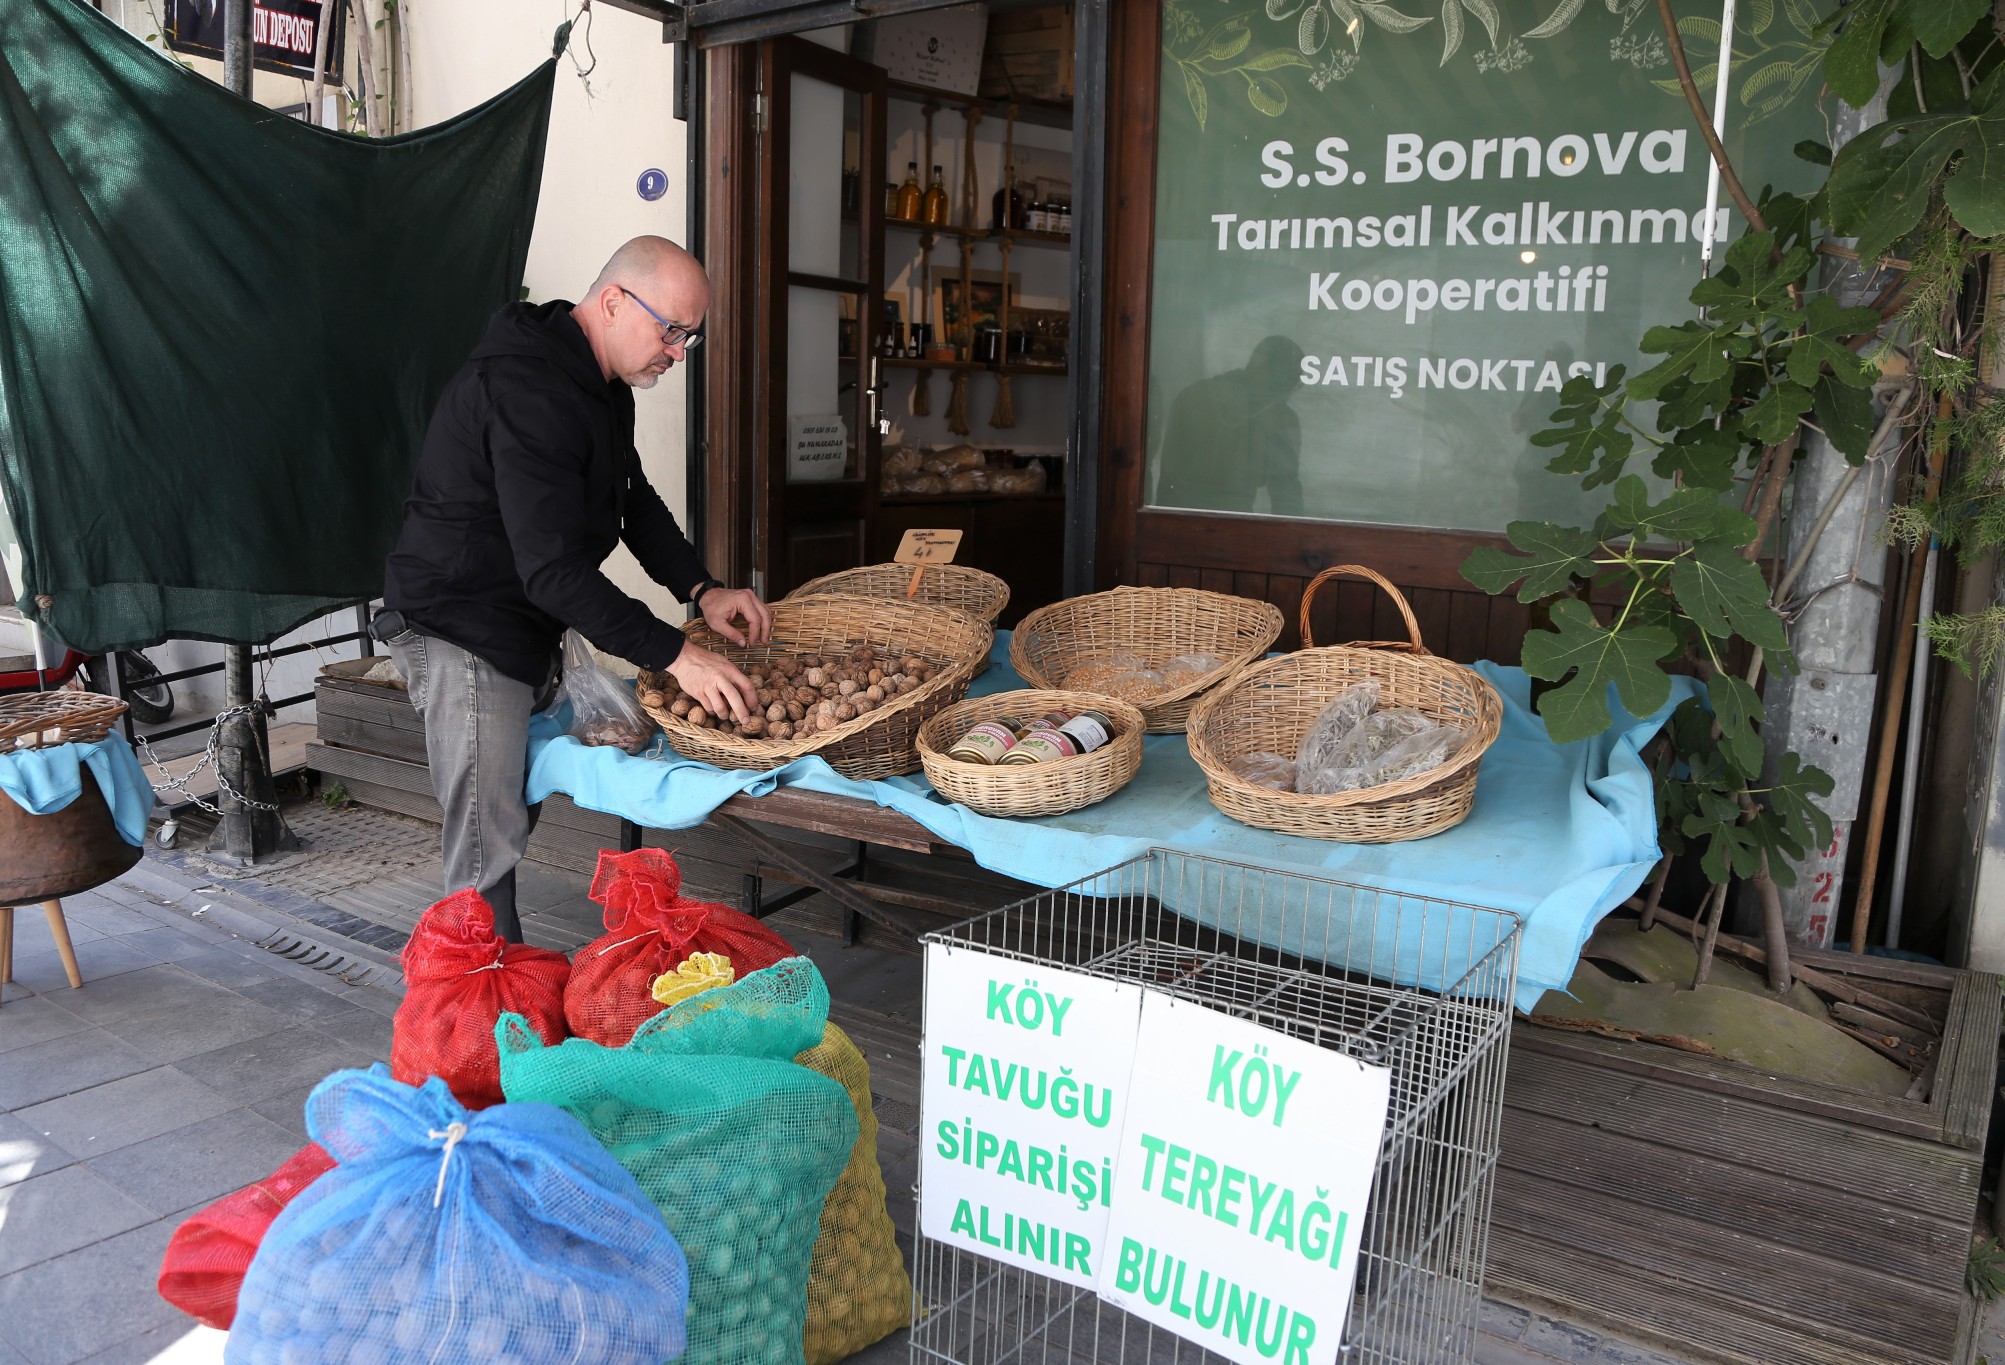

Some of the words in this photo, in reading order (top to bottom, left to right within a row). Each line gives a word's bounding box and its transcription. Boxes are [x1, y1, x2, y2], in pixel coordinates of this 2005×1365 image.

[270, 12, 313, 54] DEPOSU
[648, 176, 653, 189] 9
[1259, 136, 1366, 189] S.S.
[1384, 128, 1687, 184] Bornova
[1211, 205, 1431, 250] Tarımsal
[1445, 202, 1730, 245] Kalkınma
[1308, 265, 1608, 324] Kooperatifi
[1300, 355, 1407, 398] SATIŞ
[987, 979, 1073, 1037] KÖY
[942, 1045, 1112, 1128] TAVUĞU
[1207, 1044, 1302, 1126] KÖY
[937, 1117, 1112, 1211] SİPARİŞİ
[1140, 1134, 1348, 1270] TEREYAĞI
[950, 1199, 1092, 1278] ALINIR
[1115, 1237, 1317, 1365] BULUNUR
